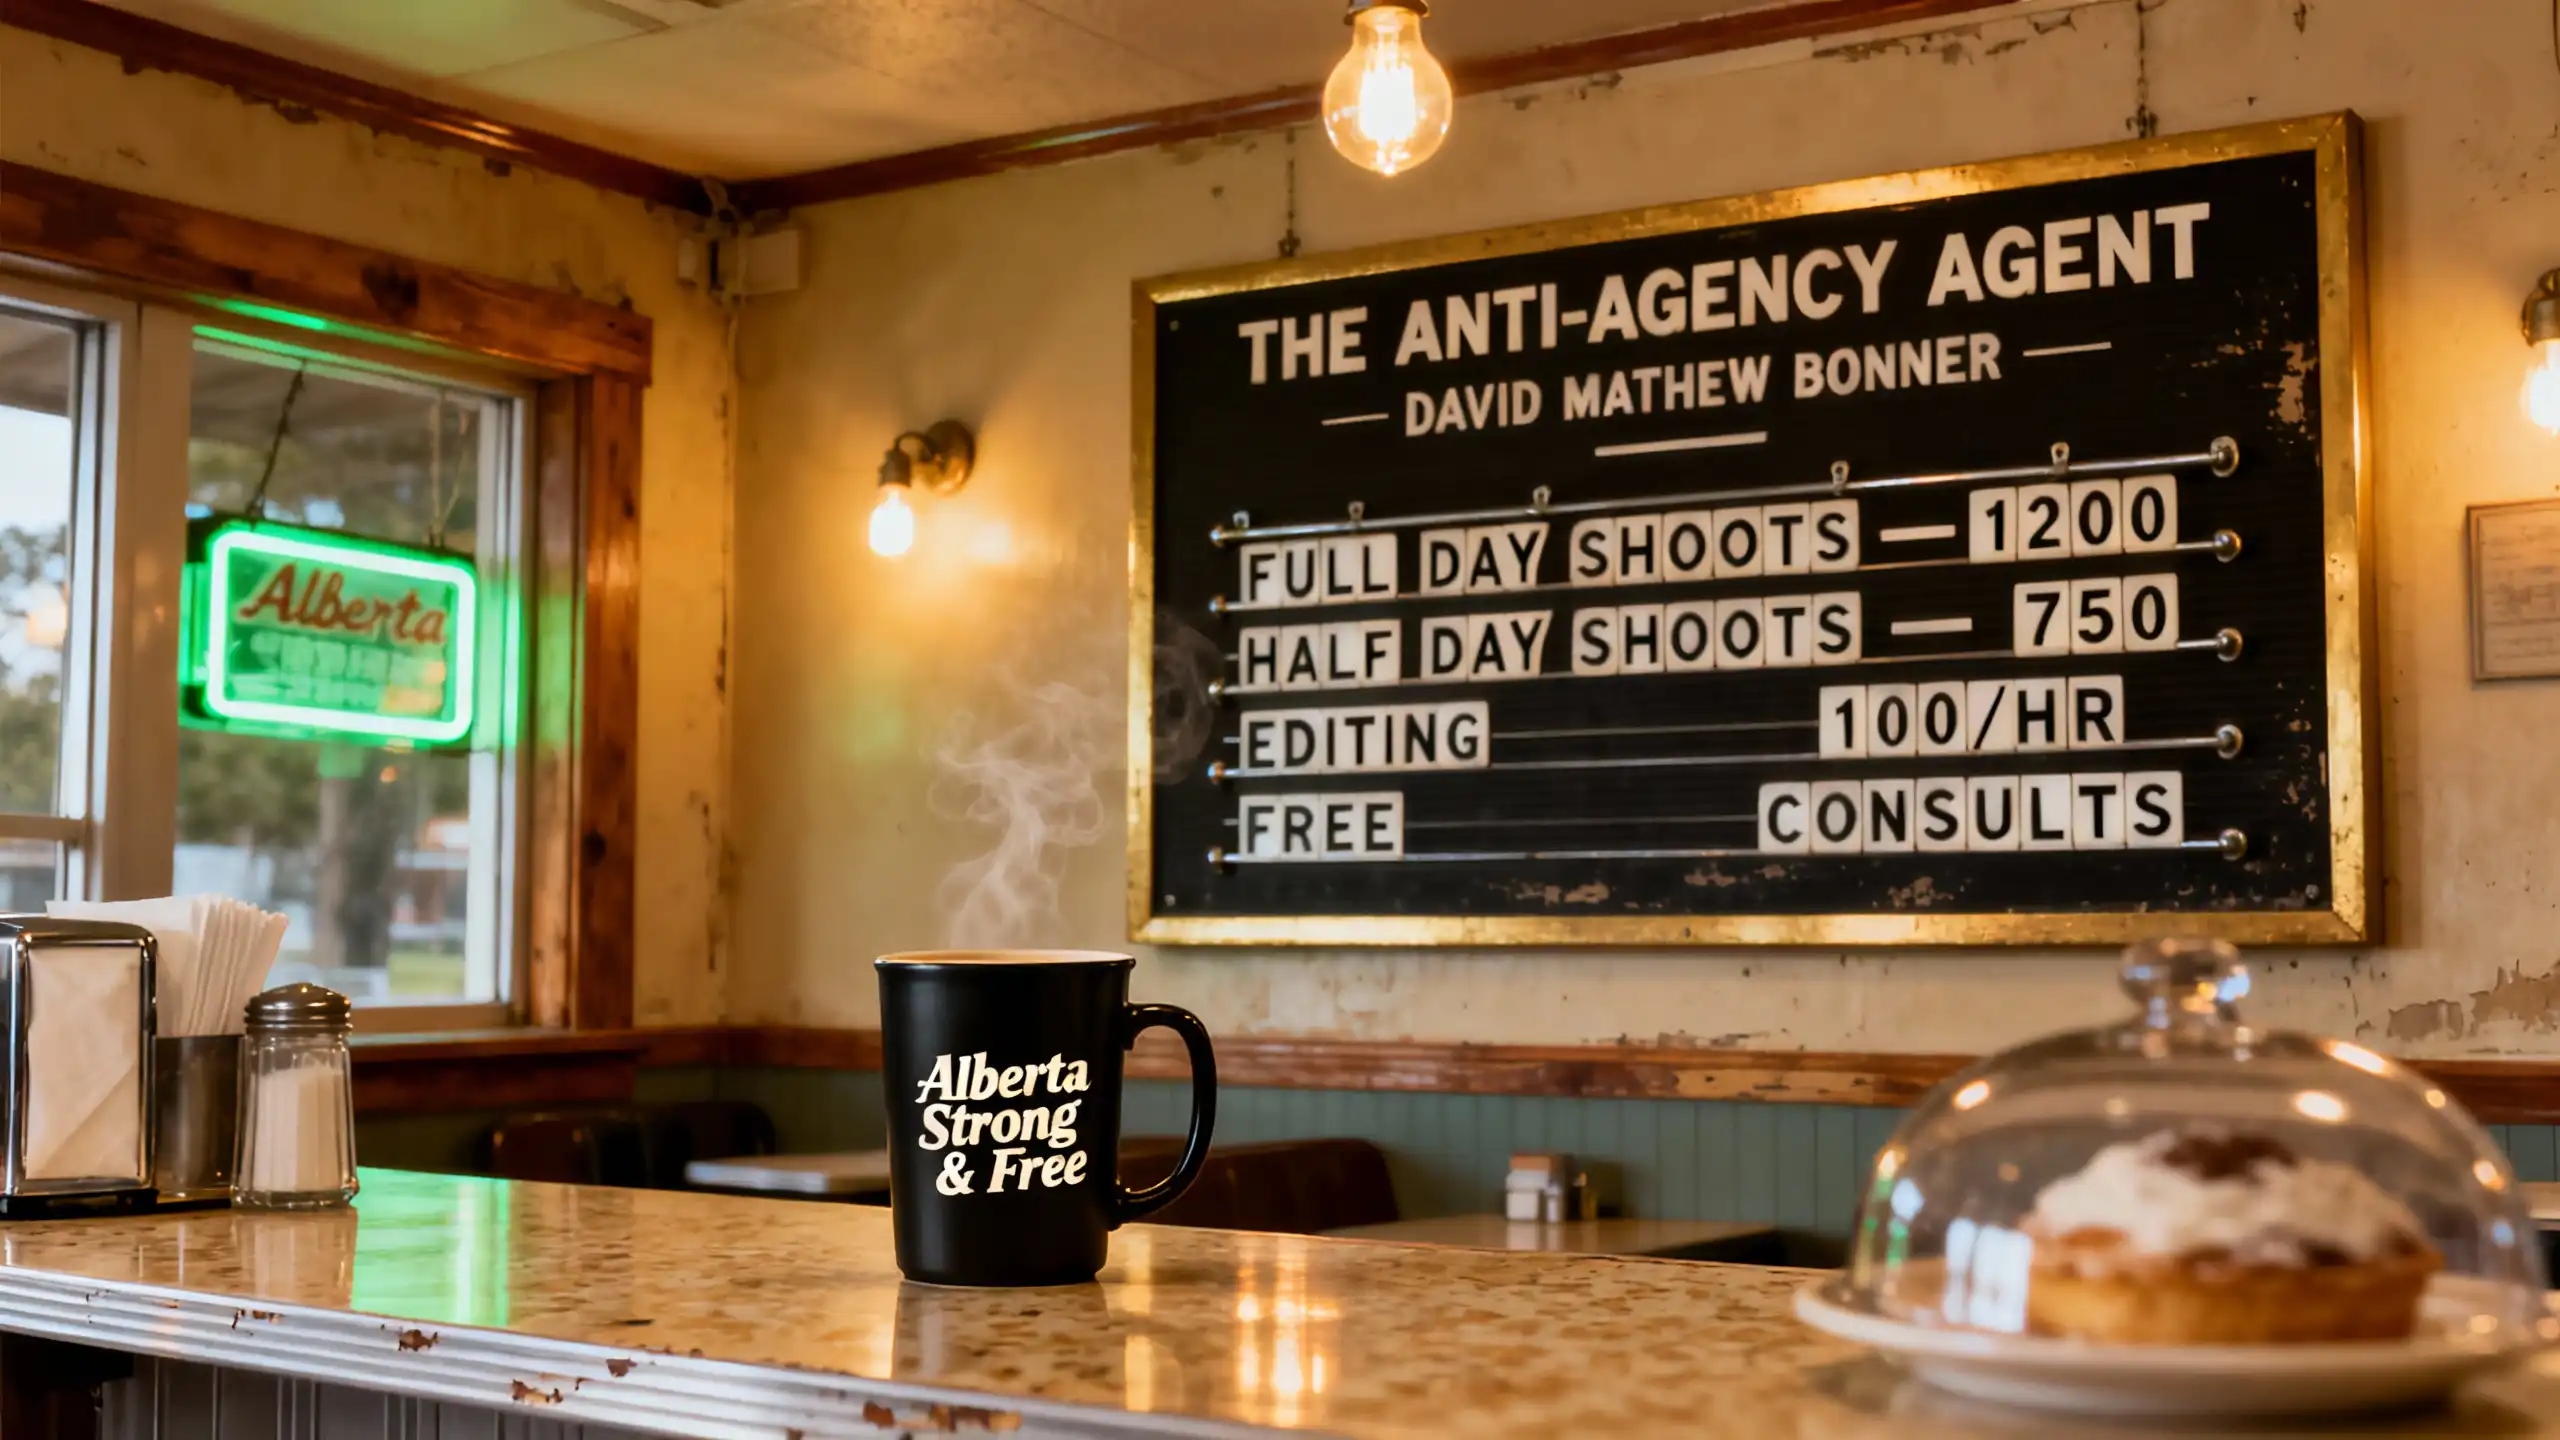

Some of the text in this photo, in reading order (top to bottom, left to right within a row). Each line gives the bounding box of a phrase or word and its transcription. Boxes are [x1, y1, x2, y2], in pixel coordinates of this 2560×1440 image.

[1239, 202, 2210, 384] THE ANTI-AGENCY AGENT
[1405, 332, 2002, 437] DAVID MATHEW BONNER
[1248, 487, 2165, 602] FULL DAY SHOOTS 1200
[240, 563, 447, 644] Alberta
[1247, 585, 2166, 684] HALF DAY SHOOTS 750
[1248, 686, 2114, 768] EDITING 100/HR
[1247, 784, 2171, 853] FREE CONSULTS
[915, 1052, 1091, 1103] Alberta
[918, 1099, 1082, 1151] Strong
[935, 1147, 1087, 1196] & Free
